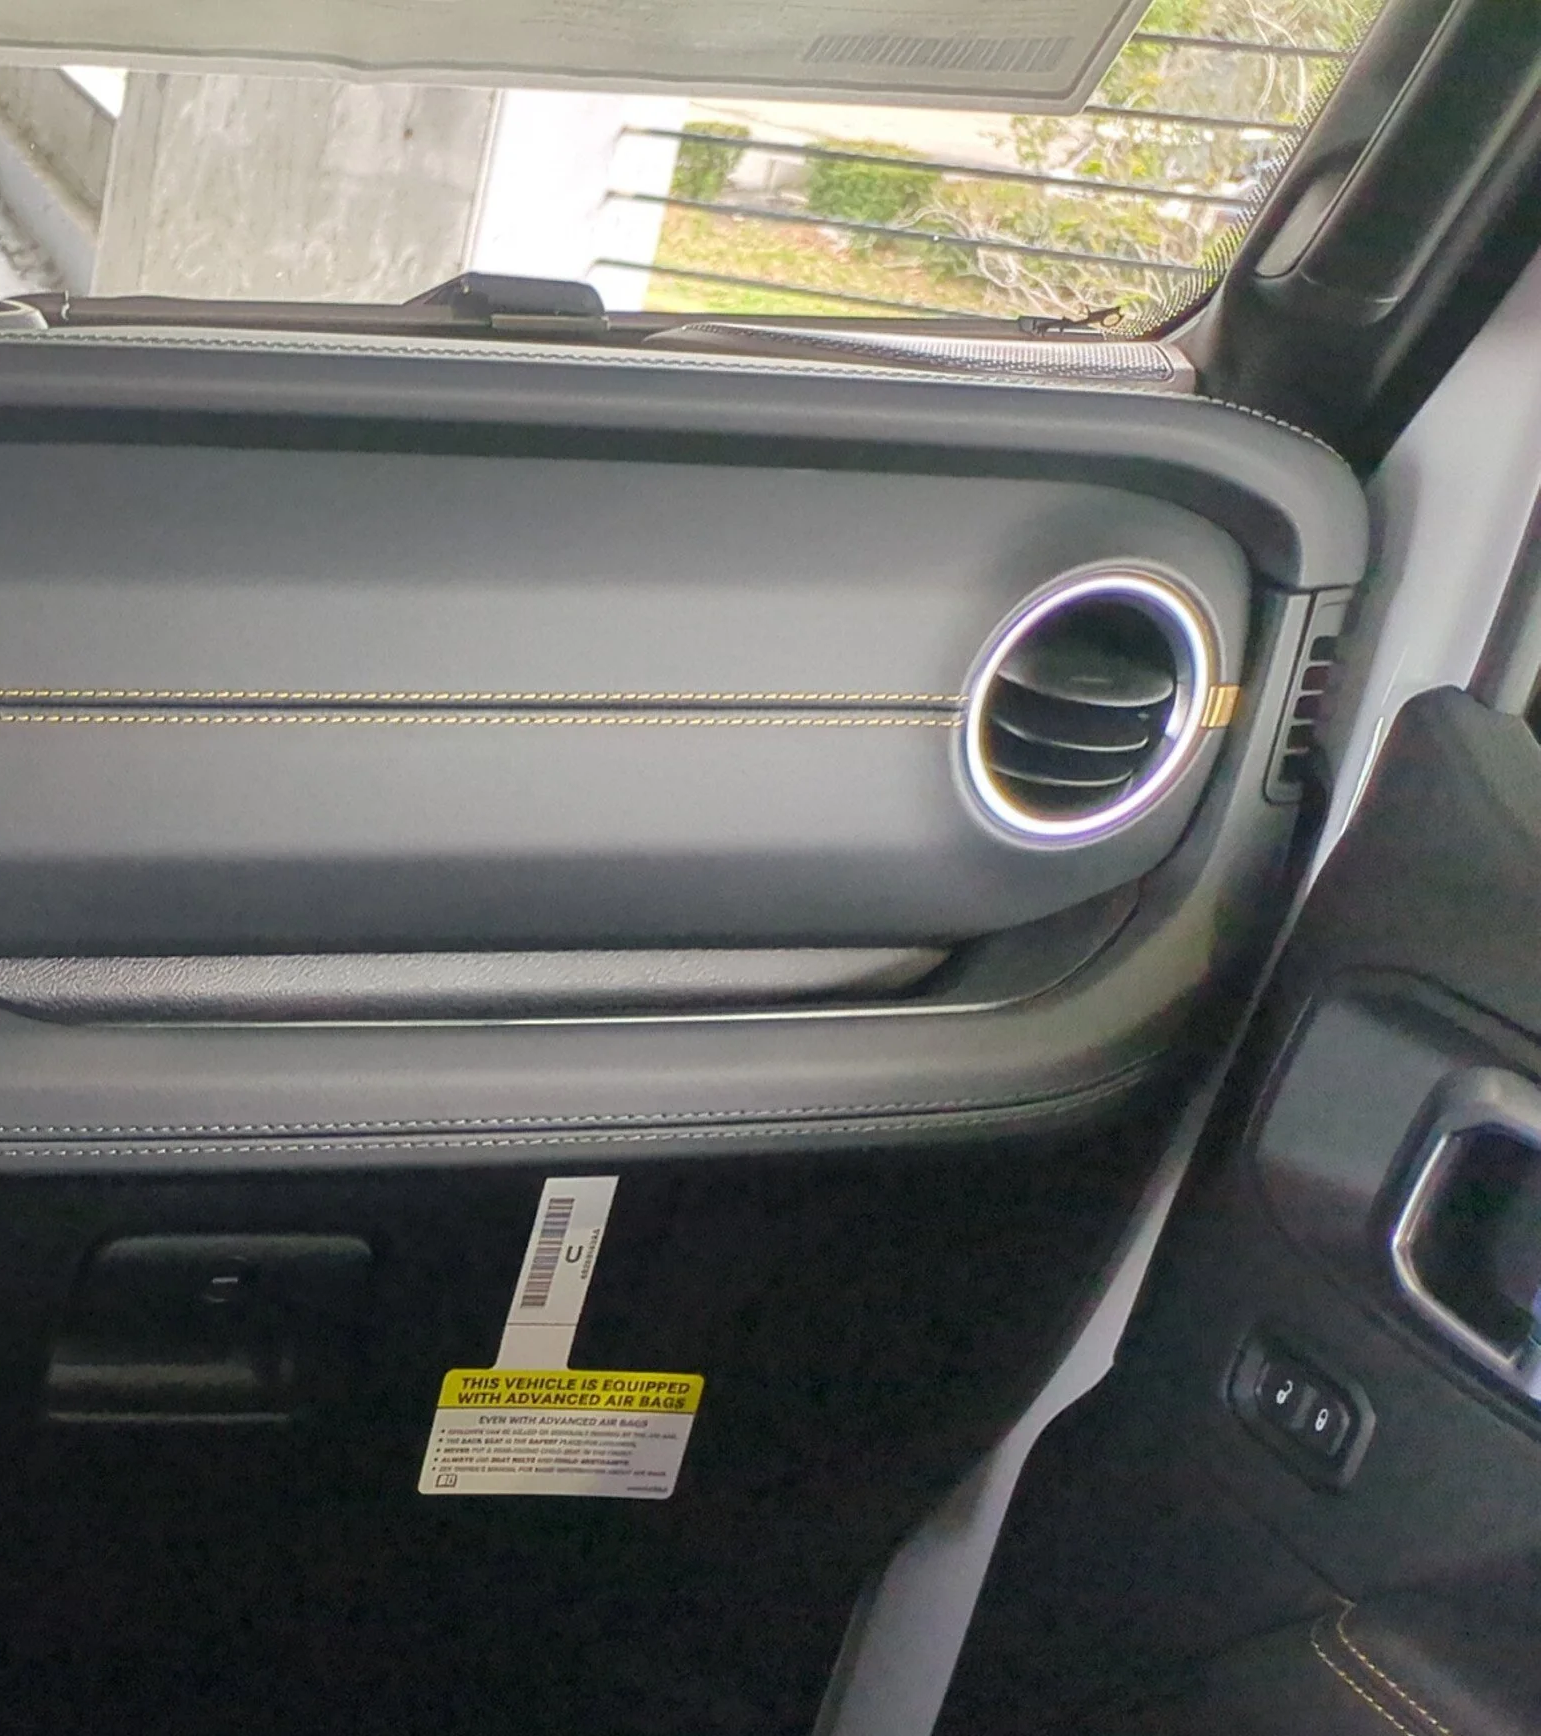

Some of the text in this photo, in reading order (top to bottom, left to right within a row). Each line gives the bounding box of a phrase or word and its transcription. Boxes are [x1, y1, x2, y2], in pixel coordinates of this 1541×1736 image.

[565, 1244, 583, 1264] U
[460, 1376, 692, 1396] THIS VEHICLE IS EQUIPPED
[456, 1391, 688, 1411] WITH ADVANCED AIR BAGS
[478, 1415, 649, 1429] EVEN WITH ADVANCED AIR BAGS
